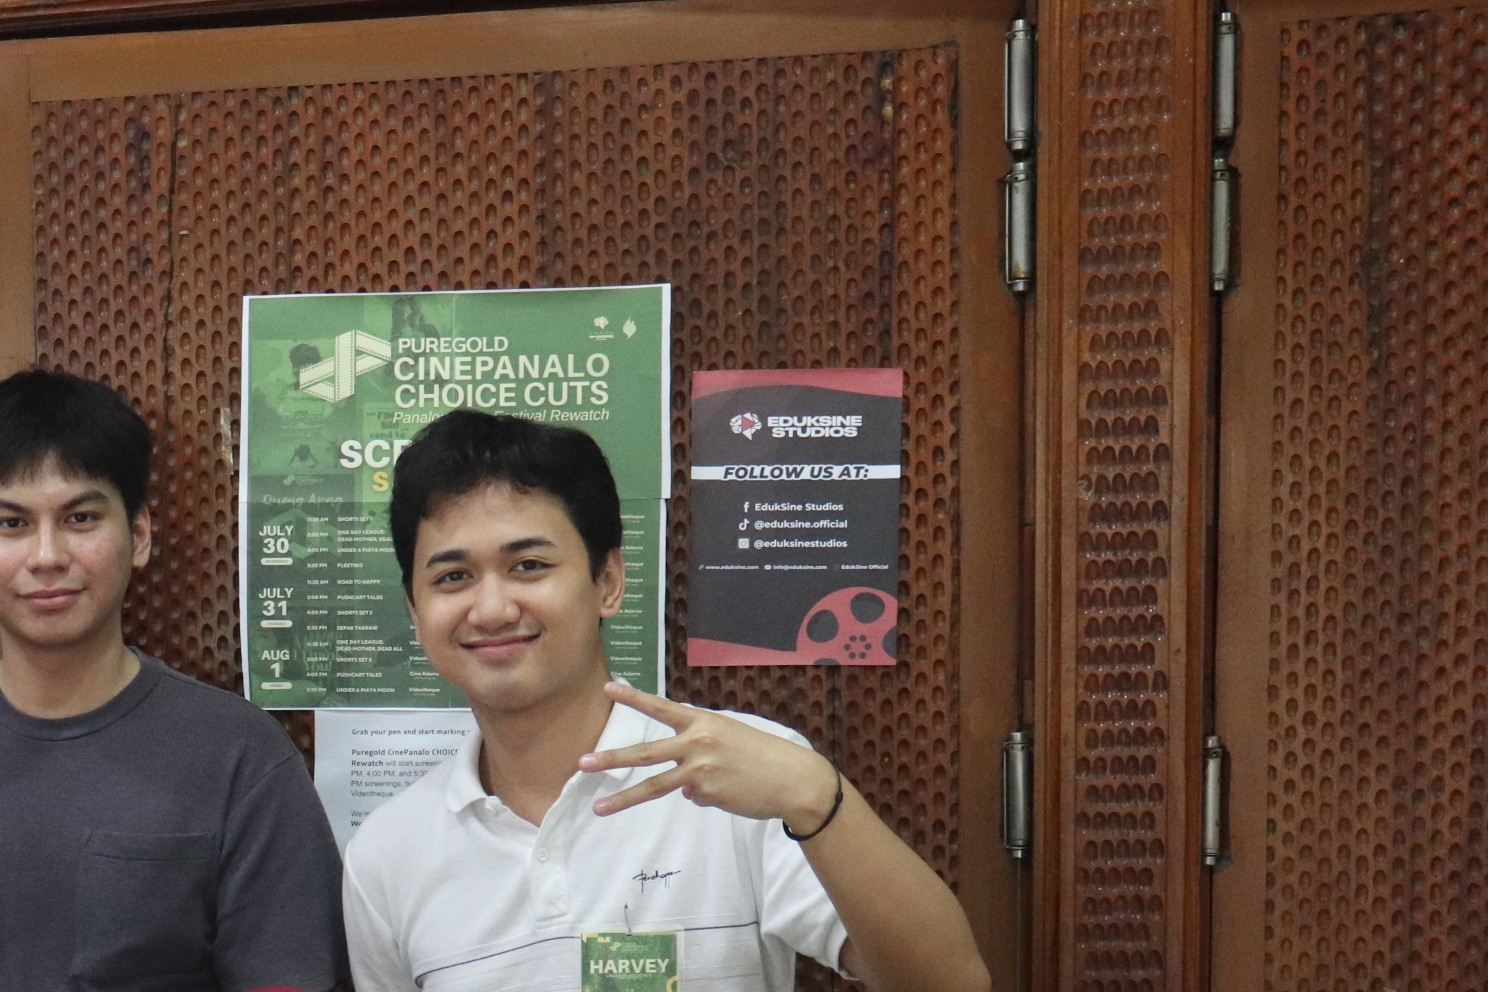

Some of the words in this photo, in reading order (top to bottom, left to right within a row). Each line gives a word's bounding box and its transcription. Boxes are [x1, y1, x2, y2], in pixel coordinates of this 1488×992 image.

[398, 336, 509, 354] PUREGOLD
[394, 352, 610, 382] CINEPANALO
[394, 382, 517, 409] CHOICE
[523, 380, 609, 406] CUTS
[549, 408, 610, 422] Rewatch
[767, 415, 863, 428] EDUKSINE
[771, 427, 858, 438] STUDIOS
[722, 465, 807, 480] FOLLOW
[809, 465, 834, 479] US
[837, 465, 870, 480] AT:
[754, 502, 803, 512] EdukSine
[805, 502, 844, 512] Studios
[754, 519, 848, 530] @eduksine.official
[259, 525, 294, 537] JULY
[262, 538, 290, 554] 30
[753, 538, 848, 550] @eduksinestudios
[259, 588, 294, 599] JULY
[262, 601, 288, 616] 31
[261, 650, 290, 661] AUG
[270, 662, 281, 678] 1
[351, 728, 369, 736] Grab
[436, 728, 466, 736] marking
[351, 749, 386, 757] Puregold
[350, 790, 394, 798] Videotheque
[589, 958, 670, 975] HARVEY
